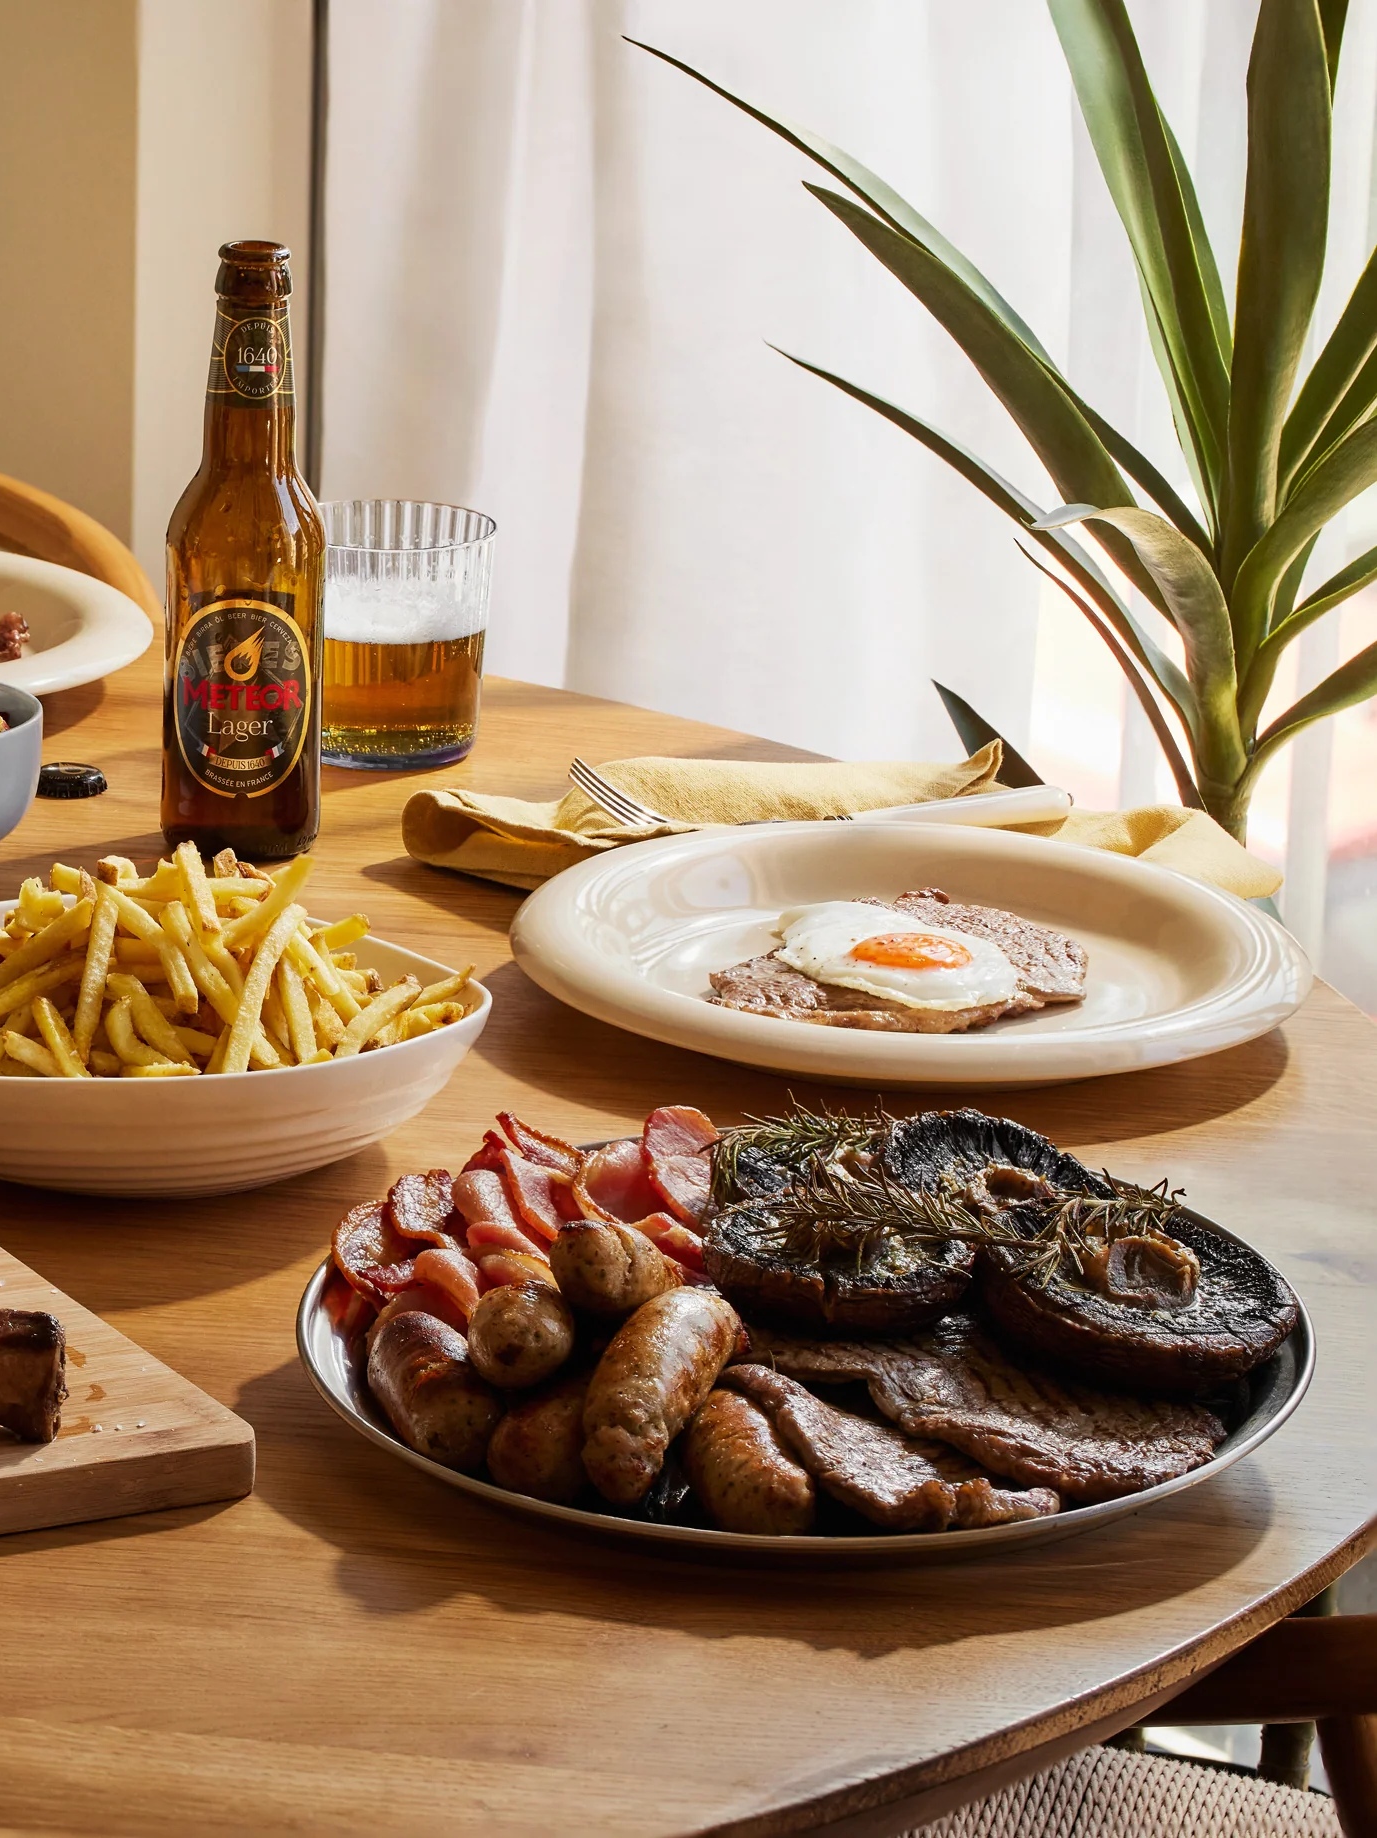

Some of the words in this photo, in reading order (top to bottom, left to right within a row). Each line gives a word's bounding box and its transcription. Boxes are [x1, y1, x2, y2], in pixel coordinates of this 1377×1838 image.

[240, 322, 275, 334] DEPUIS
[237, 346, 278, 364] 1640
[196, 622, 214, 638] BIRRA
[214, 615, 225, 624] ÖL
[227, 612, 247, 620] BEER
[250, 613, 268, 624] BIER
[269, 621, 293, 645] CERVEZA
[183, 675, 301, 711] METEOR
[208, 711, 273, 742] Lager
[215, 758, 246, 770] DEPUIS
[247, 758, 265, 769] 1640
[204, 768, 234, 787] BRASSÉE
[235, 780, 246, 788] EN
[247, 771, 274, 787] FRANCE
